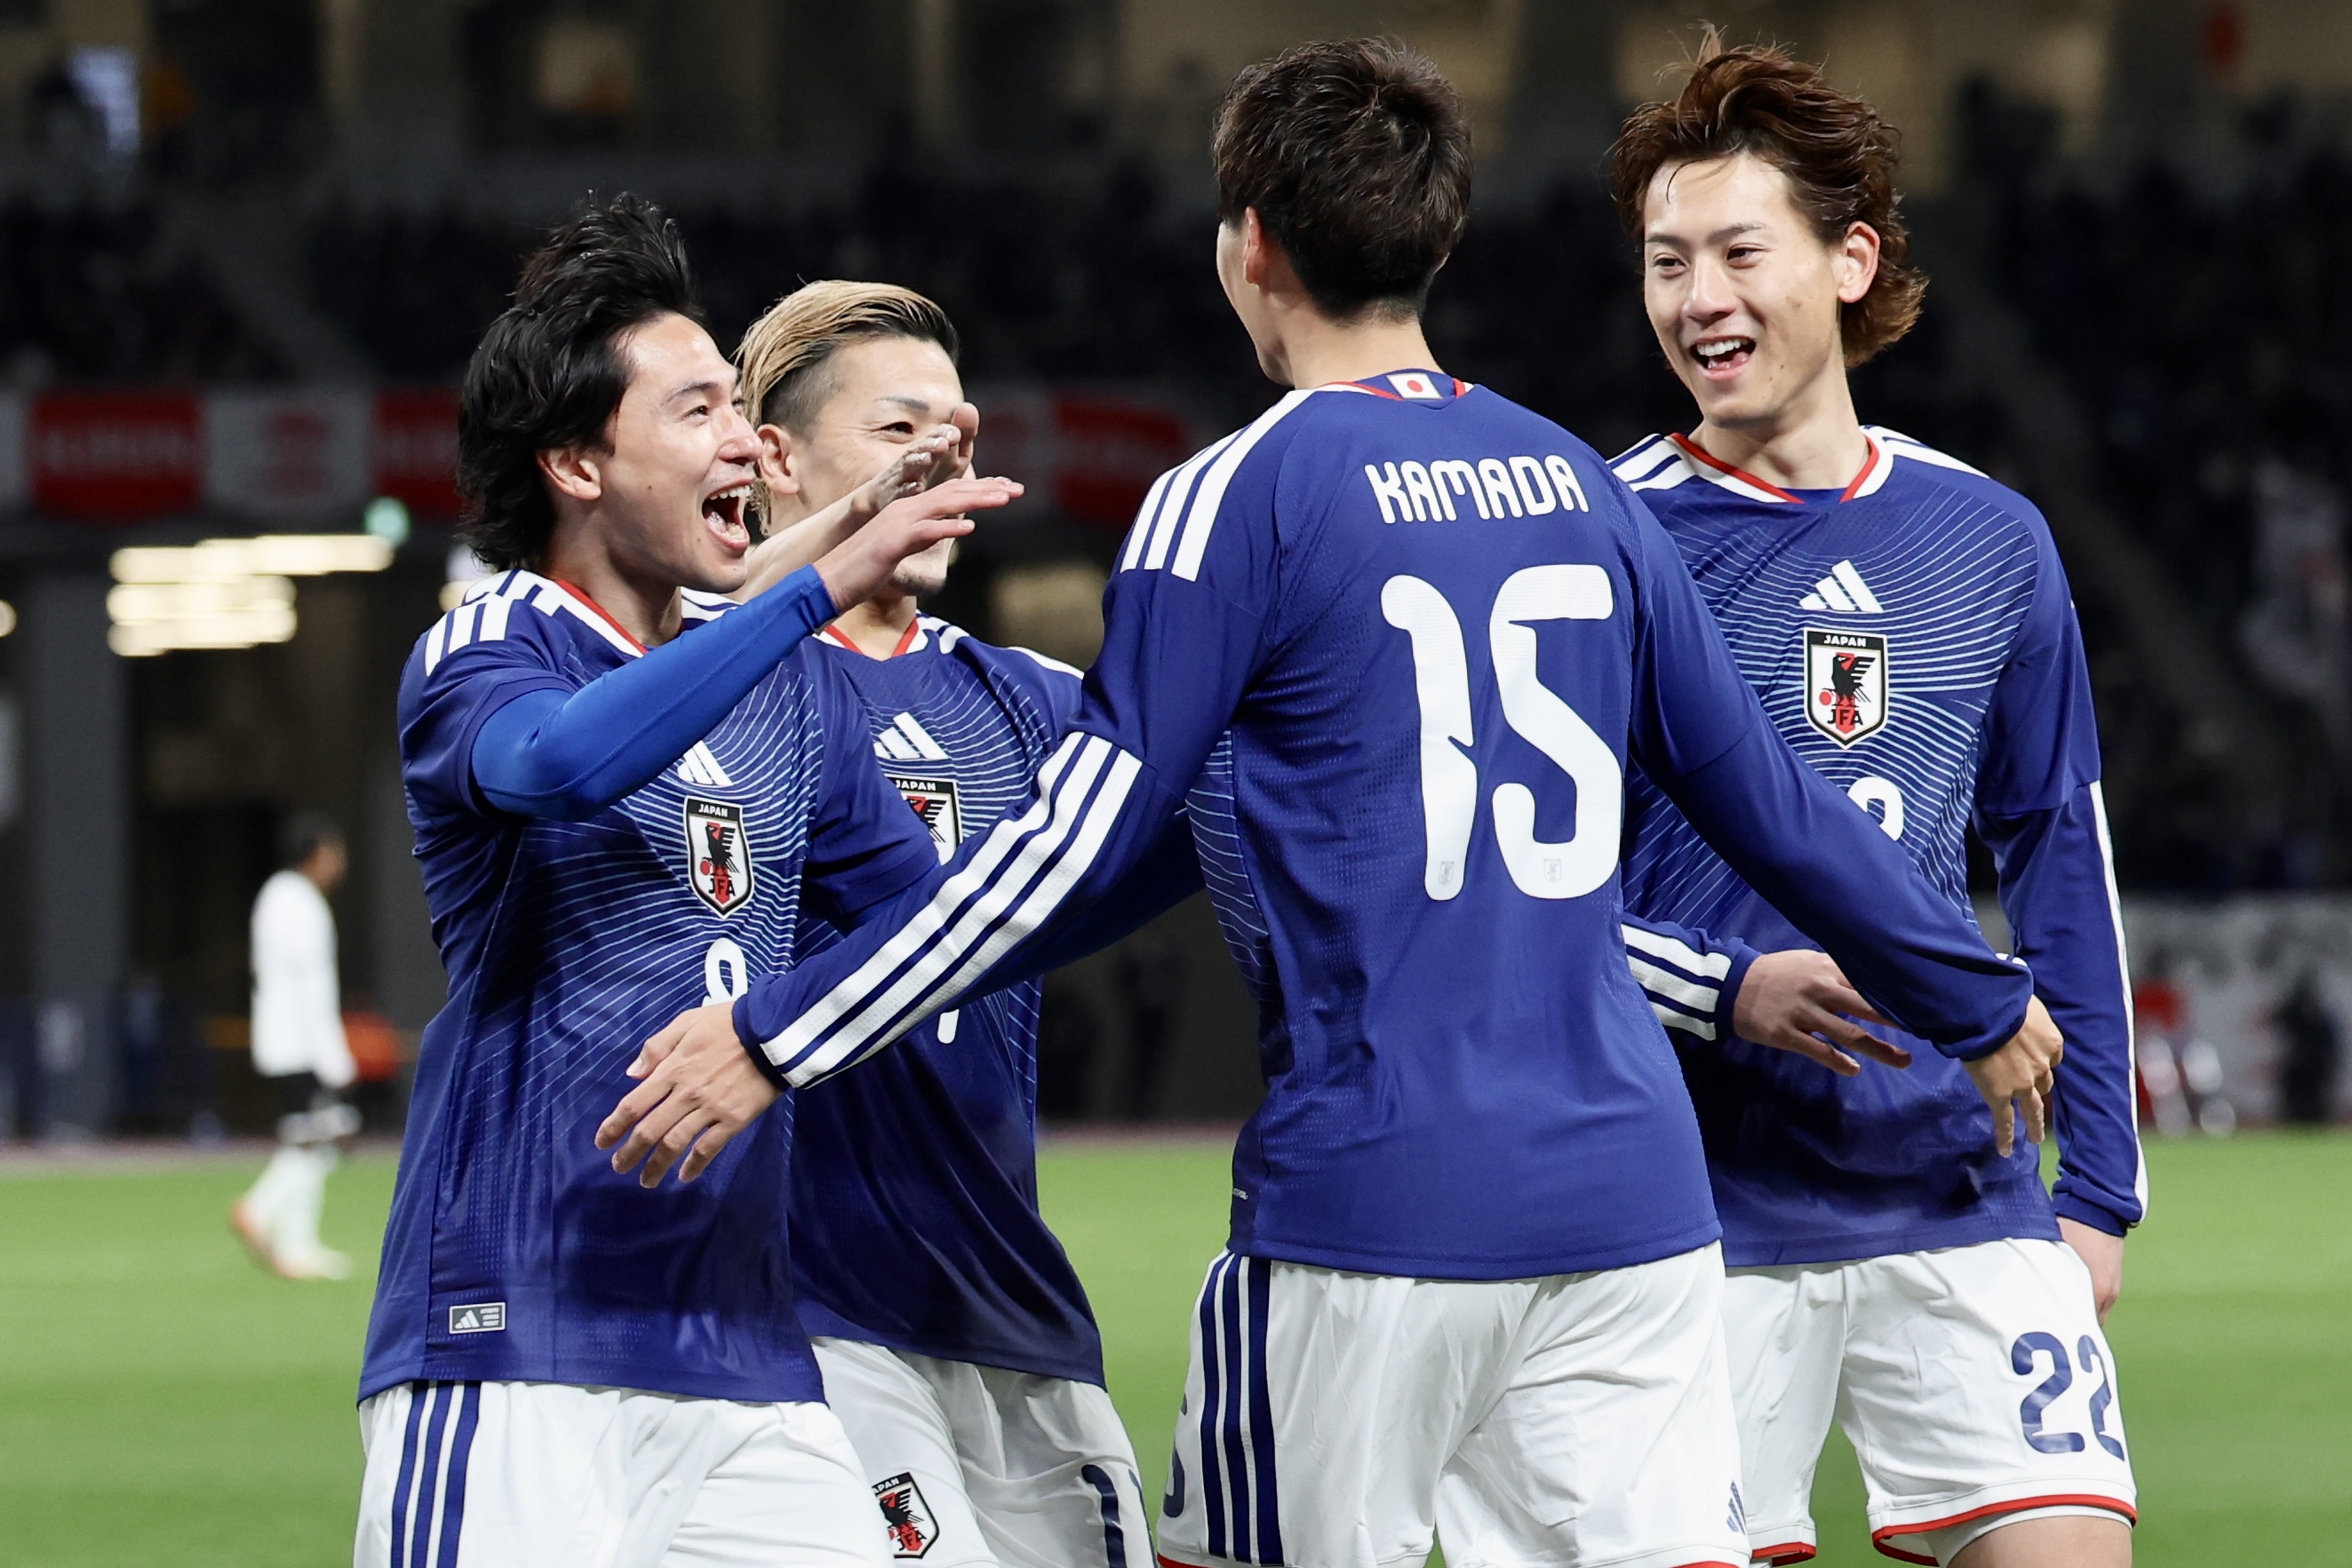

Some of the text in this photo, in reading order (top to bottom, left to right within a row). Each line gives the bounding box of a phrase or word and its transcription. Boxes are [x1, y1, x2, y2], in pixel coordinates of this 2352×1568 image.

[1364, 455, 1590, 524] KAMADA
[1823, 634, 1867, 648] JAPAN
[1827, 709, 1863, 726] JFA
[1381, 563, 1622, 901] 15
[895, 779, 937, 792] JAPAN
[698, 804, 729, 817] JAPAN
[708, 878, 736, 896] JFA
[2011, 1331, 2125, 1462] 22
